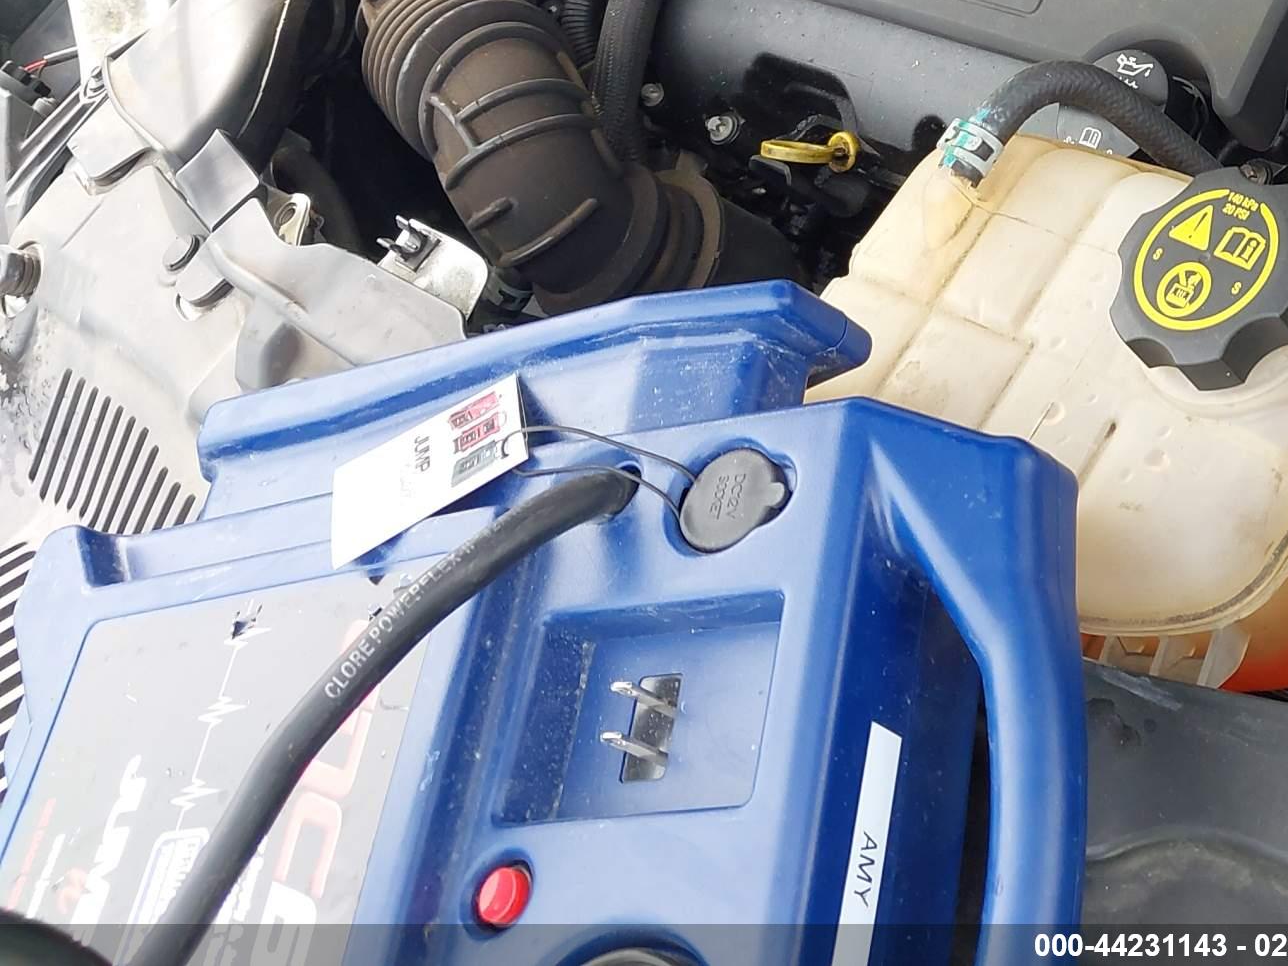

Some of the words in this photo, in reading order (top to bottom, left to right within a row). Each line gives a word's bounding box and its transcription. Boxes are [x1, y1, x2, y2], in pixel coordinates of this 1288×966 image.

[412, 436, 431, 470] JUMP
[317, 638, 380, 701] CLORE
[852, 833, 877, 908] AMY
